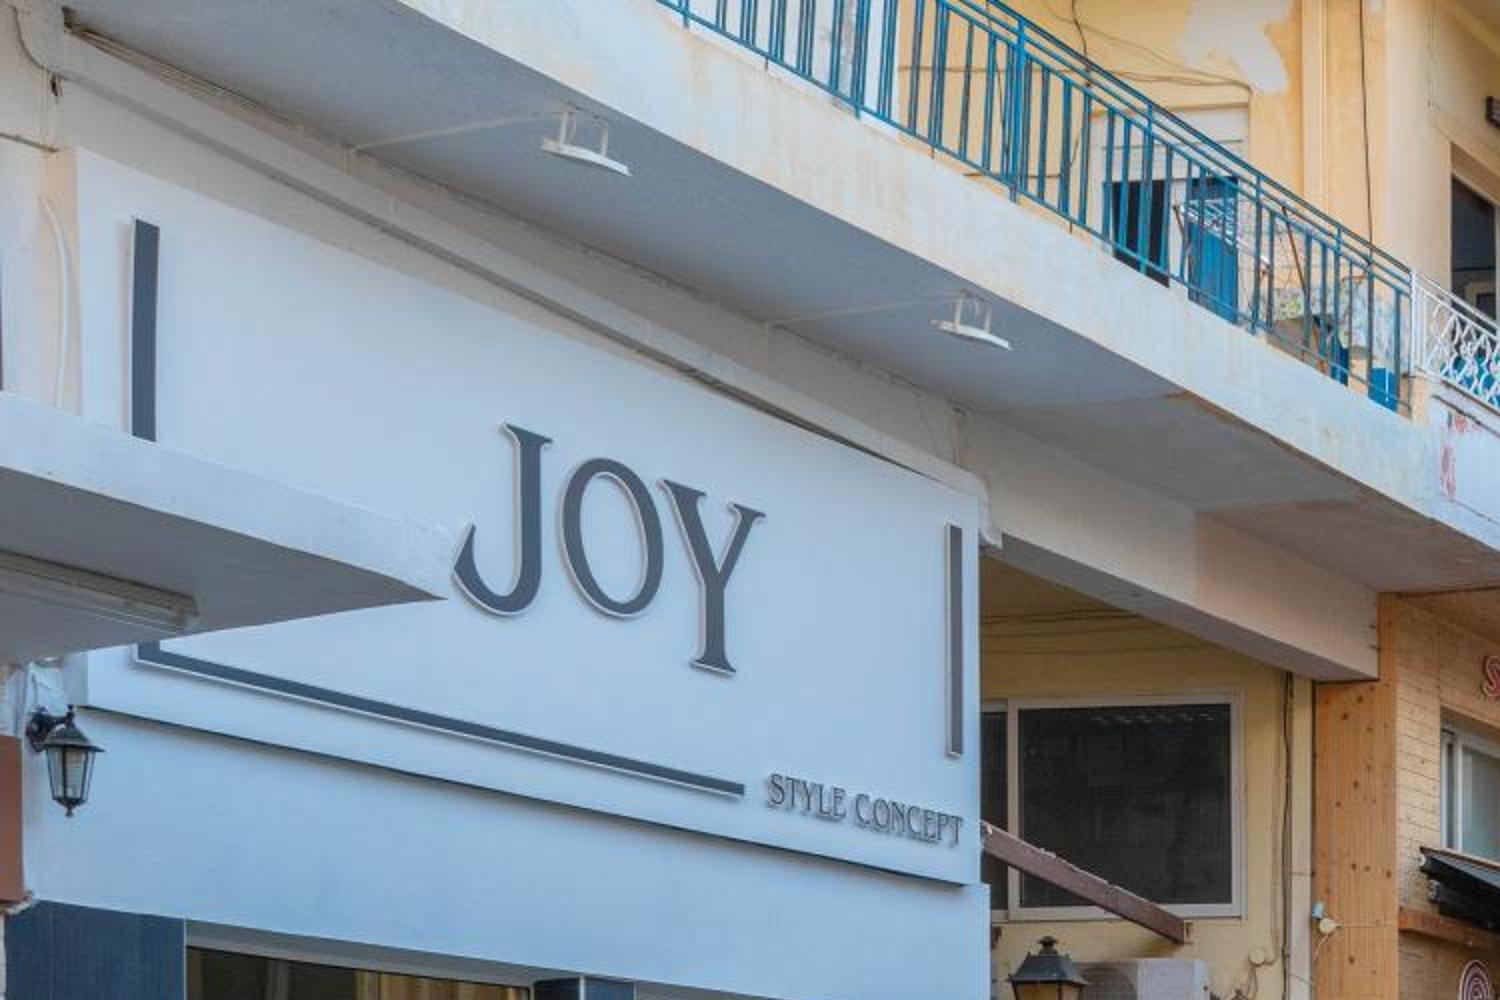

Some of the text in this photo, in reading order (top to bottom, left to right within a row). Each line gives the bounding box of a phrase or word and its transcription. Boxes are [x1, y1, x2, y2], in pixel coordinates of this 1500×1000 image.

[452, 421, 767, 677] JOY
[768, 773, 964, 846] STYLE CONCEPT
